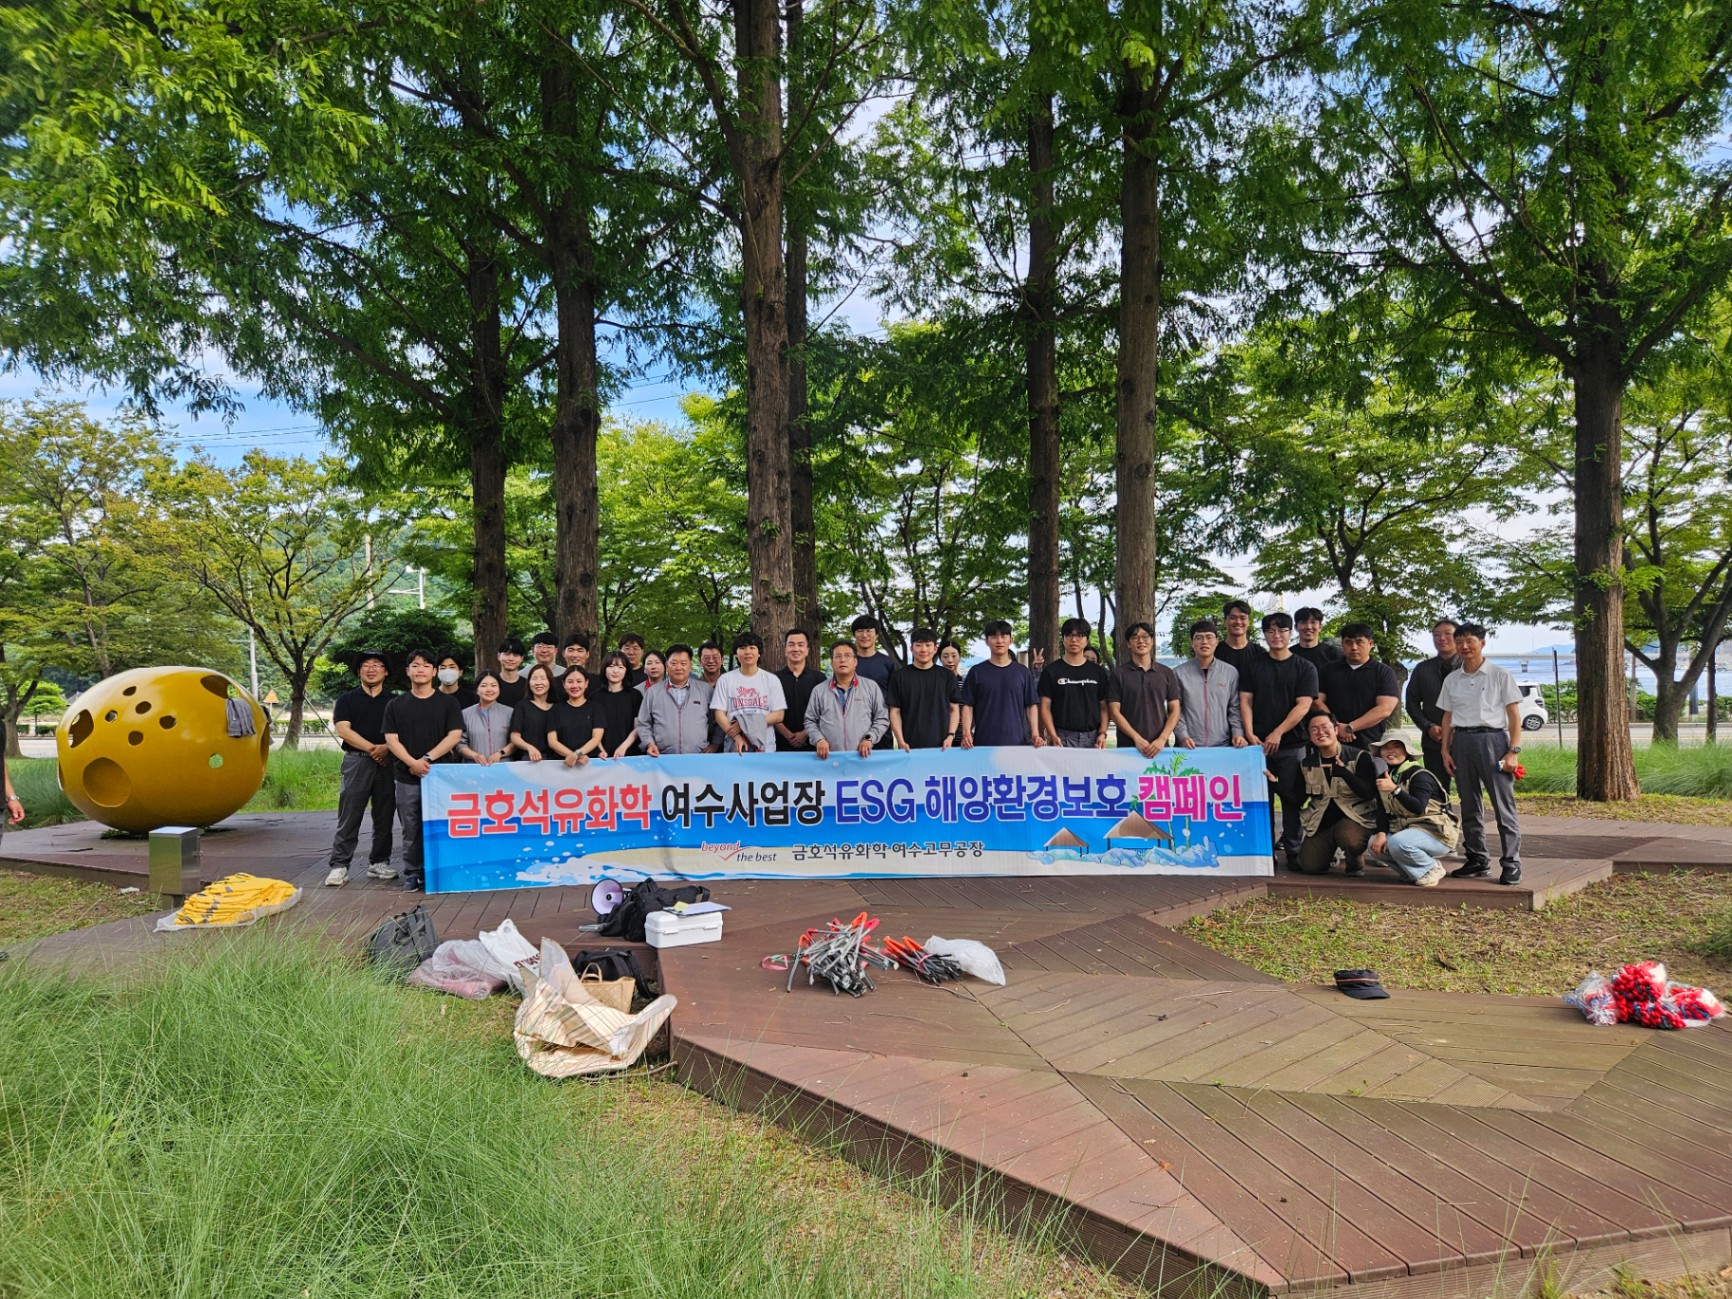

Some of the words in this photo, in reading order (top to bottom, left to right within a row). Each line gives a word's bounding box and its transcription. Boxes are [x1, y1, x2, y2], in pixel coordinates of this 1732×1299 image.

[731, 695, 768, 709] ONSDALE
[447, 783, 653, 838] 금호석유화학
[661, 780, 825, 828] 여수사업장
[836, 778, 916, 824] ESG
[925, 774, 1128, 822] 해양환경보호
[1138, 774, 1244, 822] 캠페인
[701, 841, 740, 853] beyond
[792, 843, 887, 861] 금호석유화학
[892, 841, 984, 858] 여수고무공장
[737, 852, 753, 862] the
[755, 852, 777, 862] best
